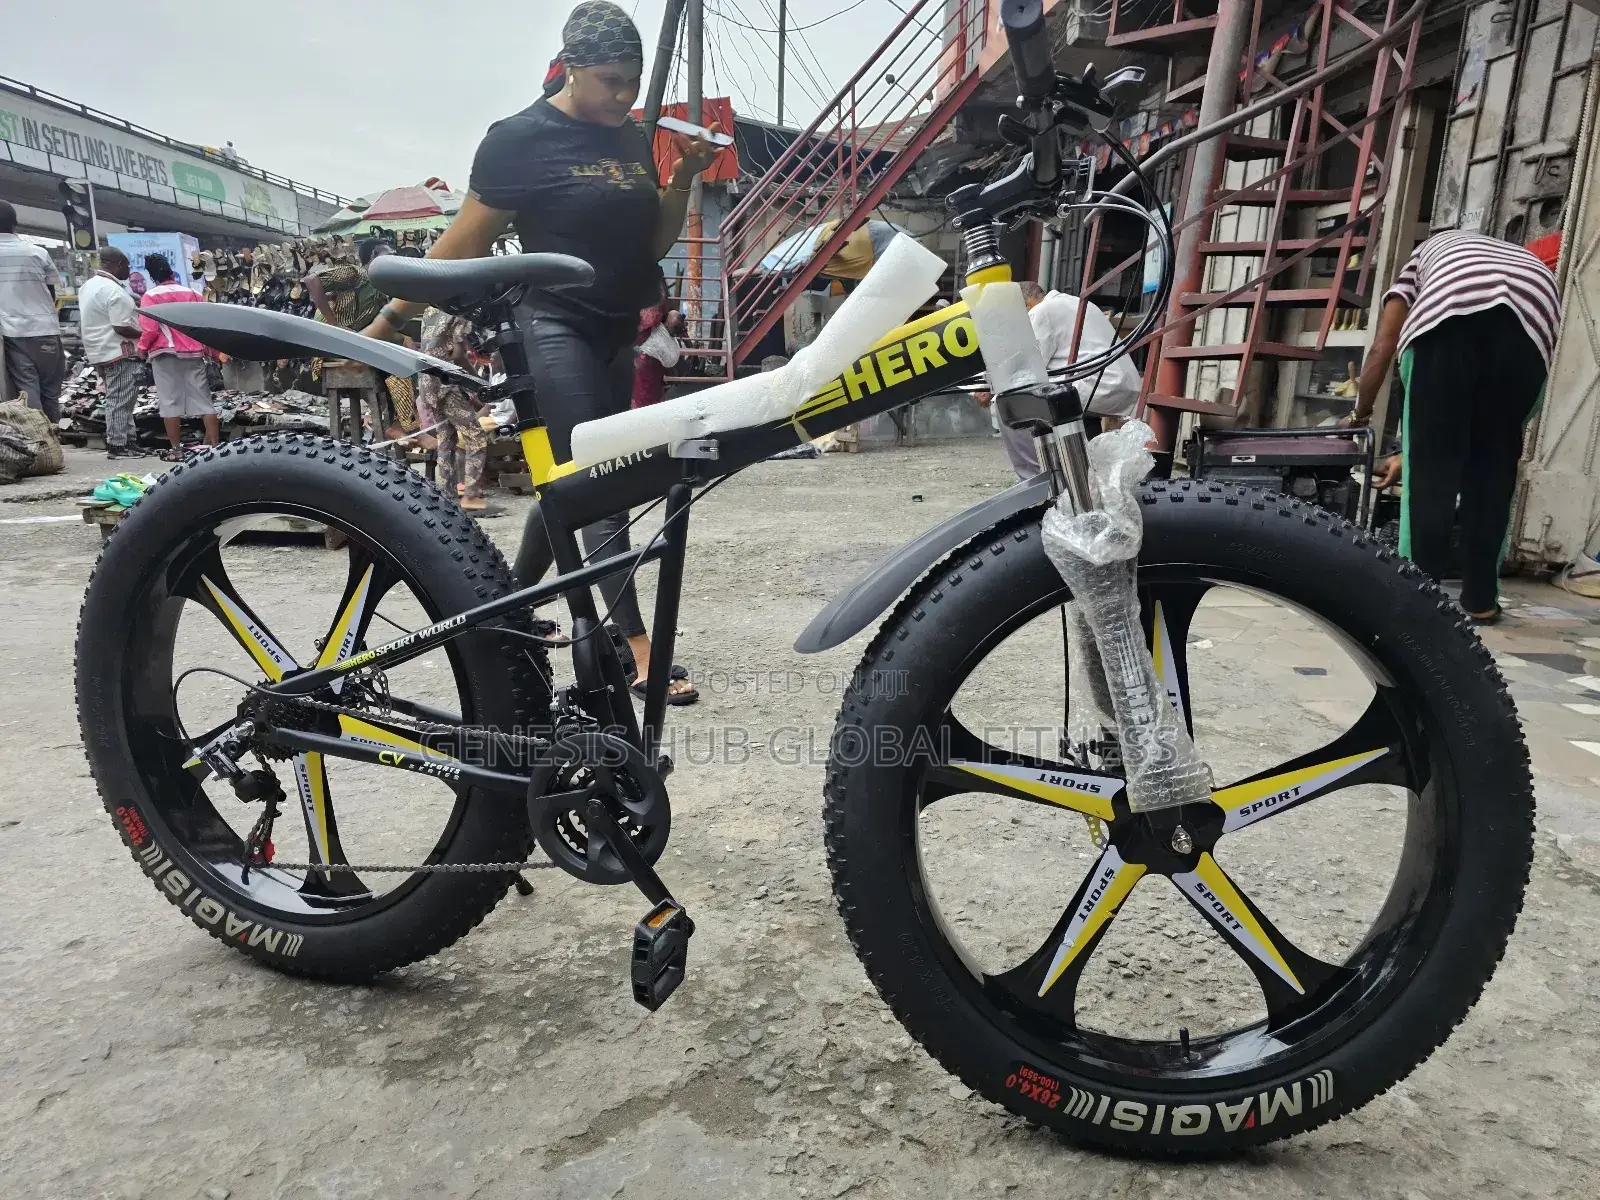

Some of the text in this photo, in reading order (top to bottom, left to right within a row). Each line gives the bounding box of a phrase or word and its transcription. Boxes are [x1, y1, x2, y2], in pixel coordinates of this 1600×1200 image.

[22, 116, 41, 150] IN
[41, 122, 110, 169] SETTLING
[109, 143, 138, 177] LIVE
[137, 151, 169, 186] BETS
[842, 316, 980, 402] HERO
[589, 448, 653, 479] 4MATIC
[247, 624, 283, 664] SPORT
[350, 614, 467, 667] HERO SPORT WORLD
[379, 750, 406, 766] CV
[424, 761, 460, 775] SPORTS
[299, 763, 315, 813] SPORT
[1037, 773, 1102, 795] SPORT
[1238, 785, 1302, 818] SPORT
[154, 858, 284, 954] MAQISI
[1082, 866, 1115, 923] SPORT
[1193, 881, 1244, 932] SPORT
[1005, 1073, 1061, 1109] 26X4.0
[1091, 1081, 1303, 1136] MAQISI
